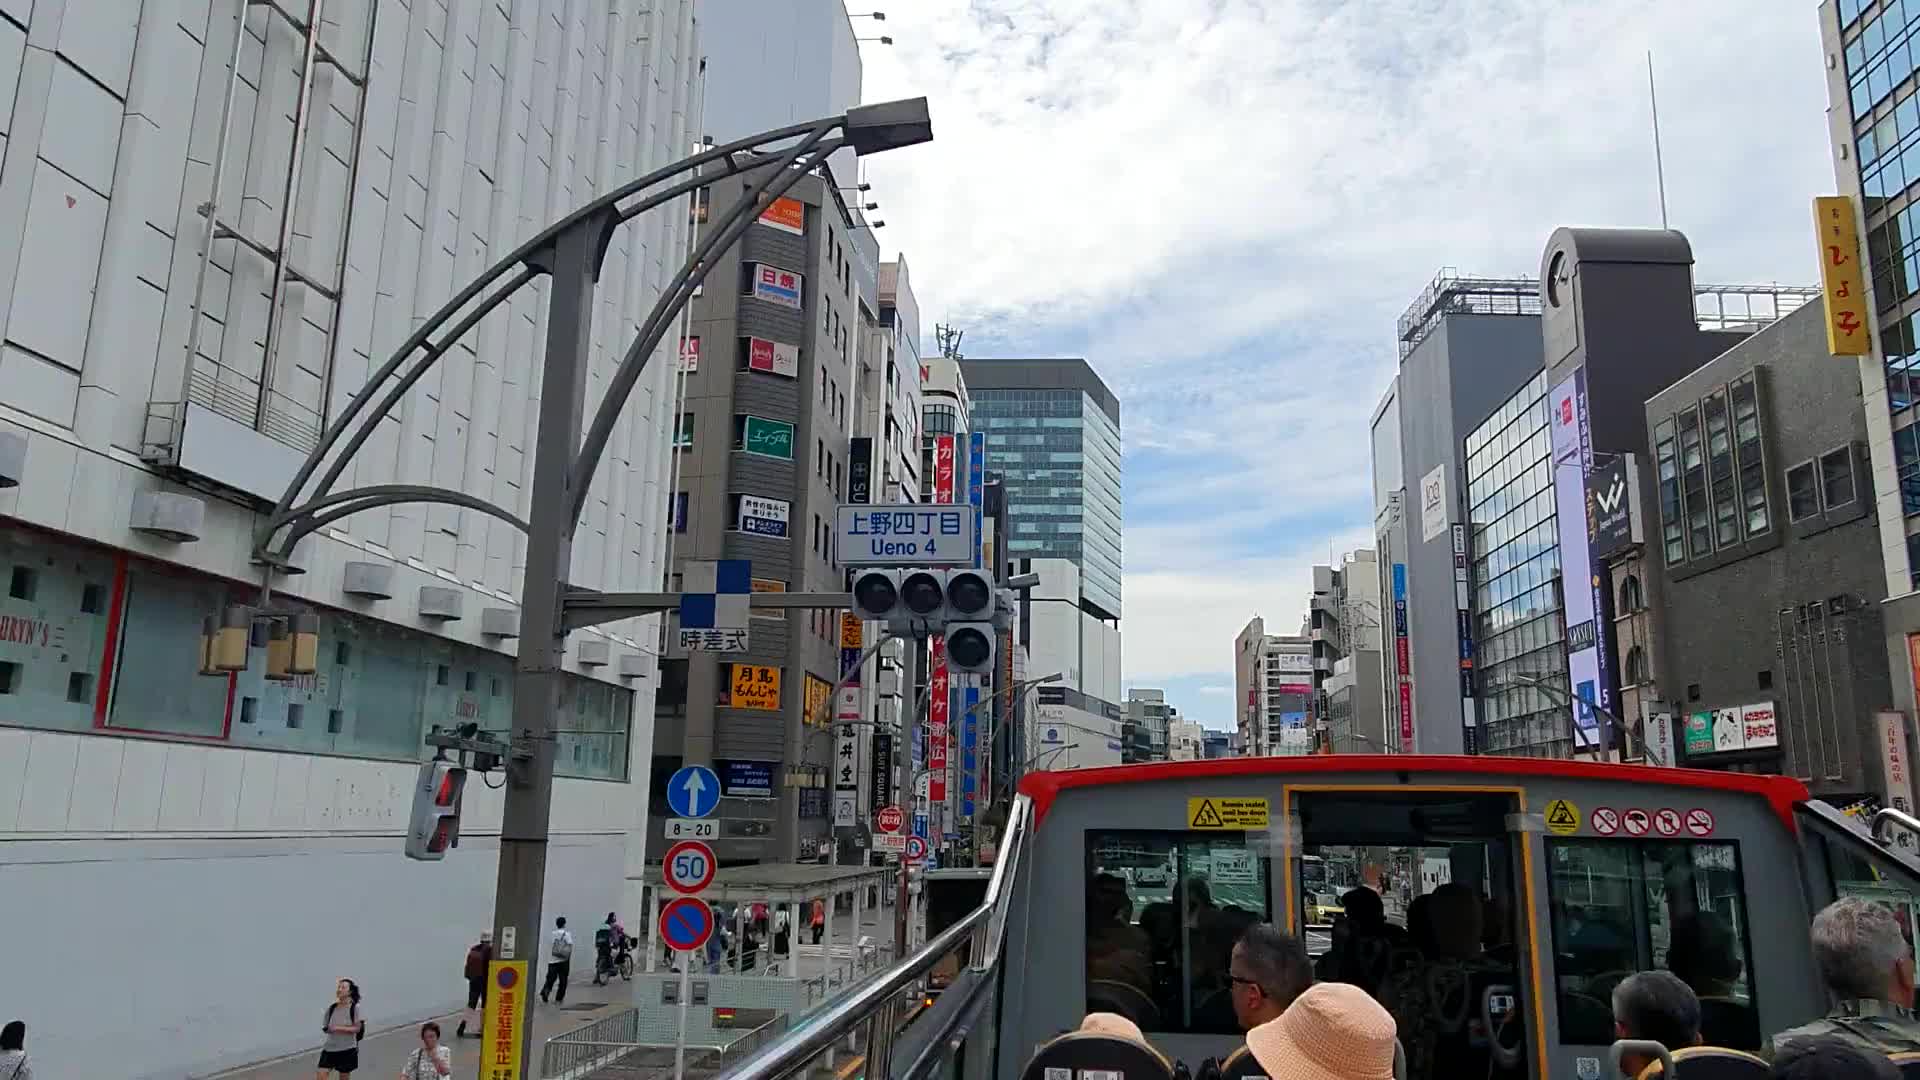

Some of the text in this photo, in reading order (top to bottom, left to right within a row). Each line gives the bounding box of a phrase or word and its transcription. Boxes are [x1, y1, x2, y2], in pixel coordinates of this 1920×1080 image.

[763, 269, 795, 290] 日焼
[848, 511, 961, 536] 上野四丁目
[871, 538, 937, 555] Ueno 4
[681, 630, 747, 650] 時差式
[740, 667, 774, 683] 月島
[735, 684, 777, 698] もんじゃ
[676, 856, 705, 879] 50
